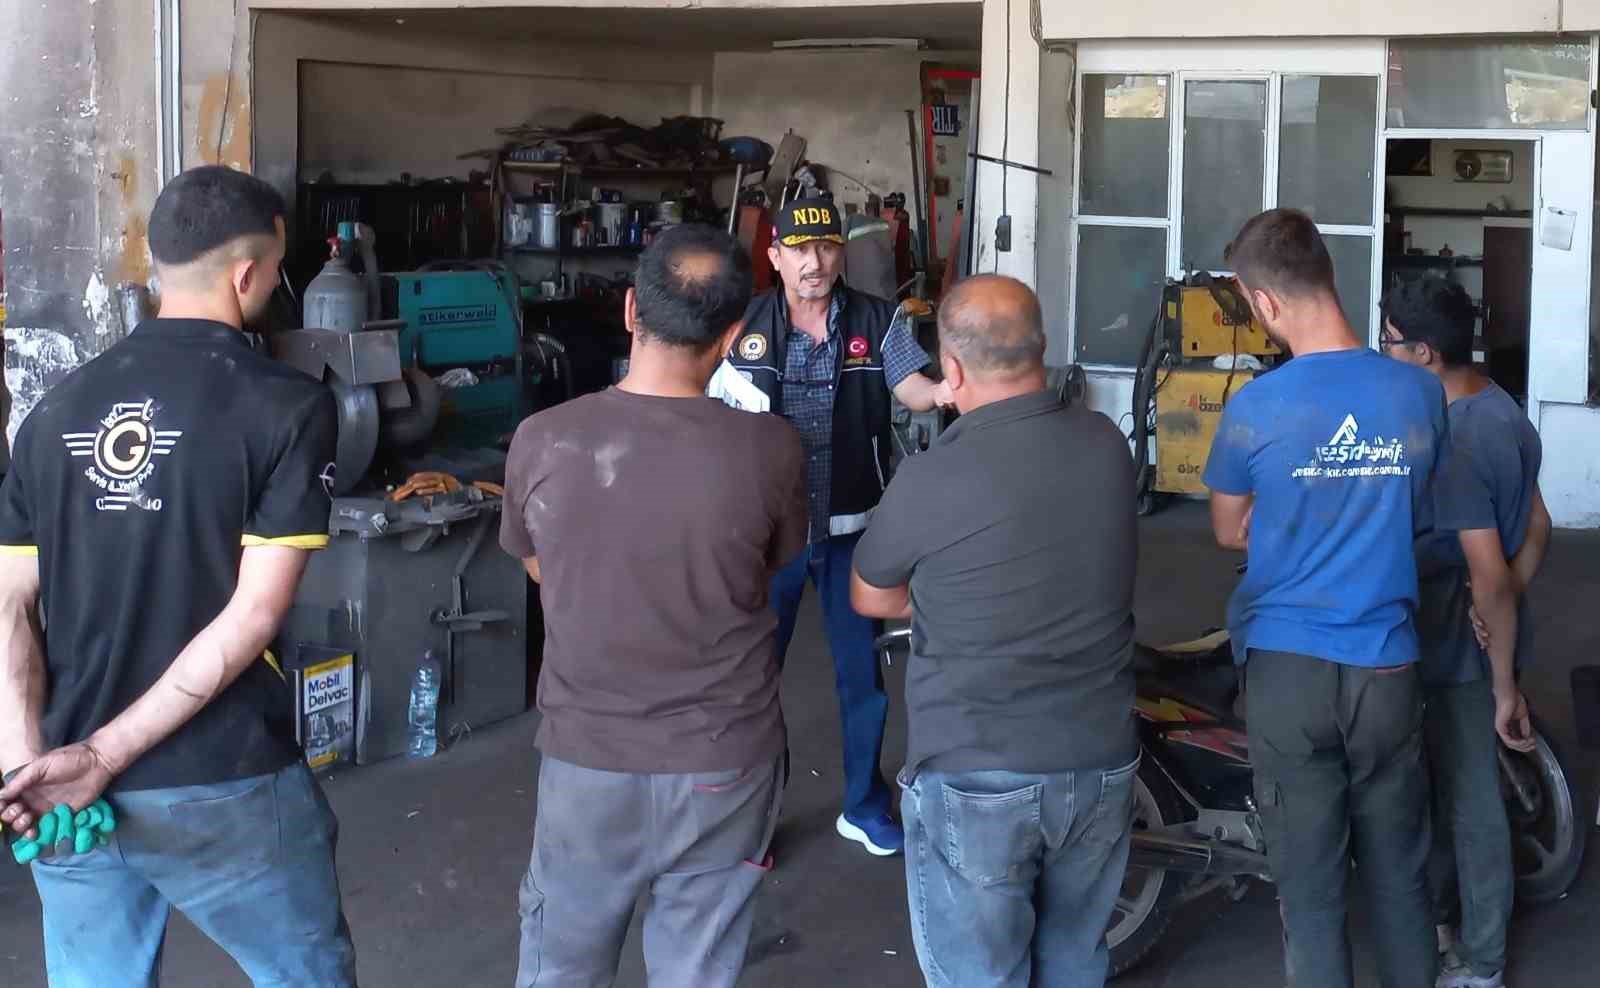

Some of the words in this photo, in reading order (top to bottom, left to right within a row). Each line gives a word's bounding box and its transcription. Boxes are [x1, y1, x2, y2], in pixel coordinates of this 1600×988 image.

[792, 207, 832, 225] NDB
[103, 420, 147, 471] G
[308, 673, 340, 693] Mobil
[308, 687, 348, 708] Delvac
